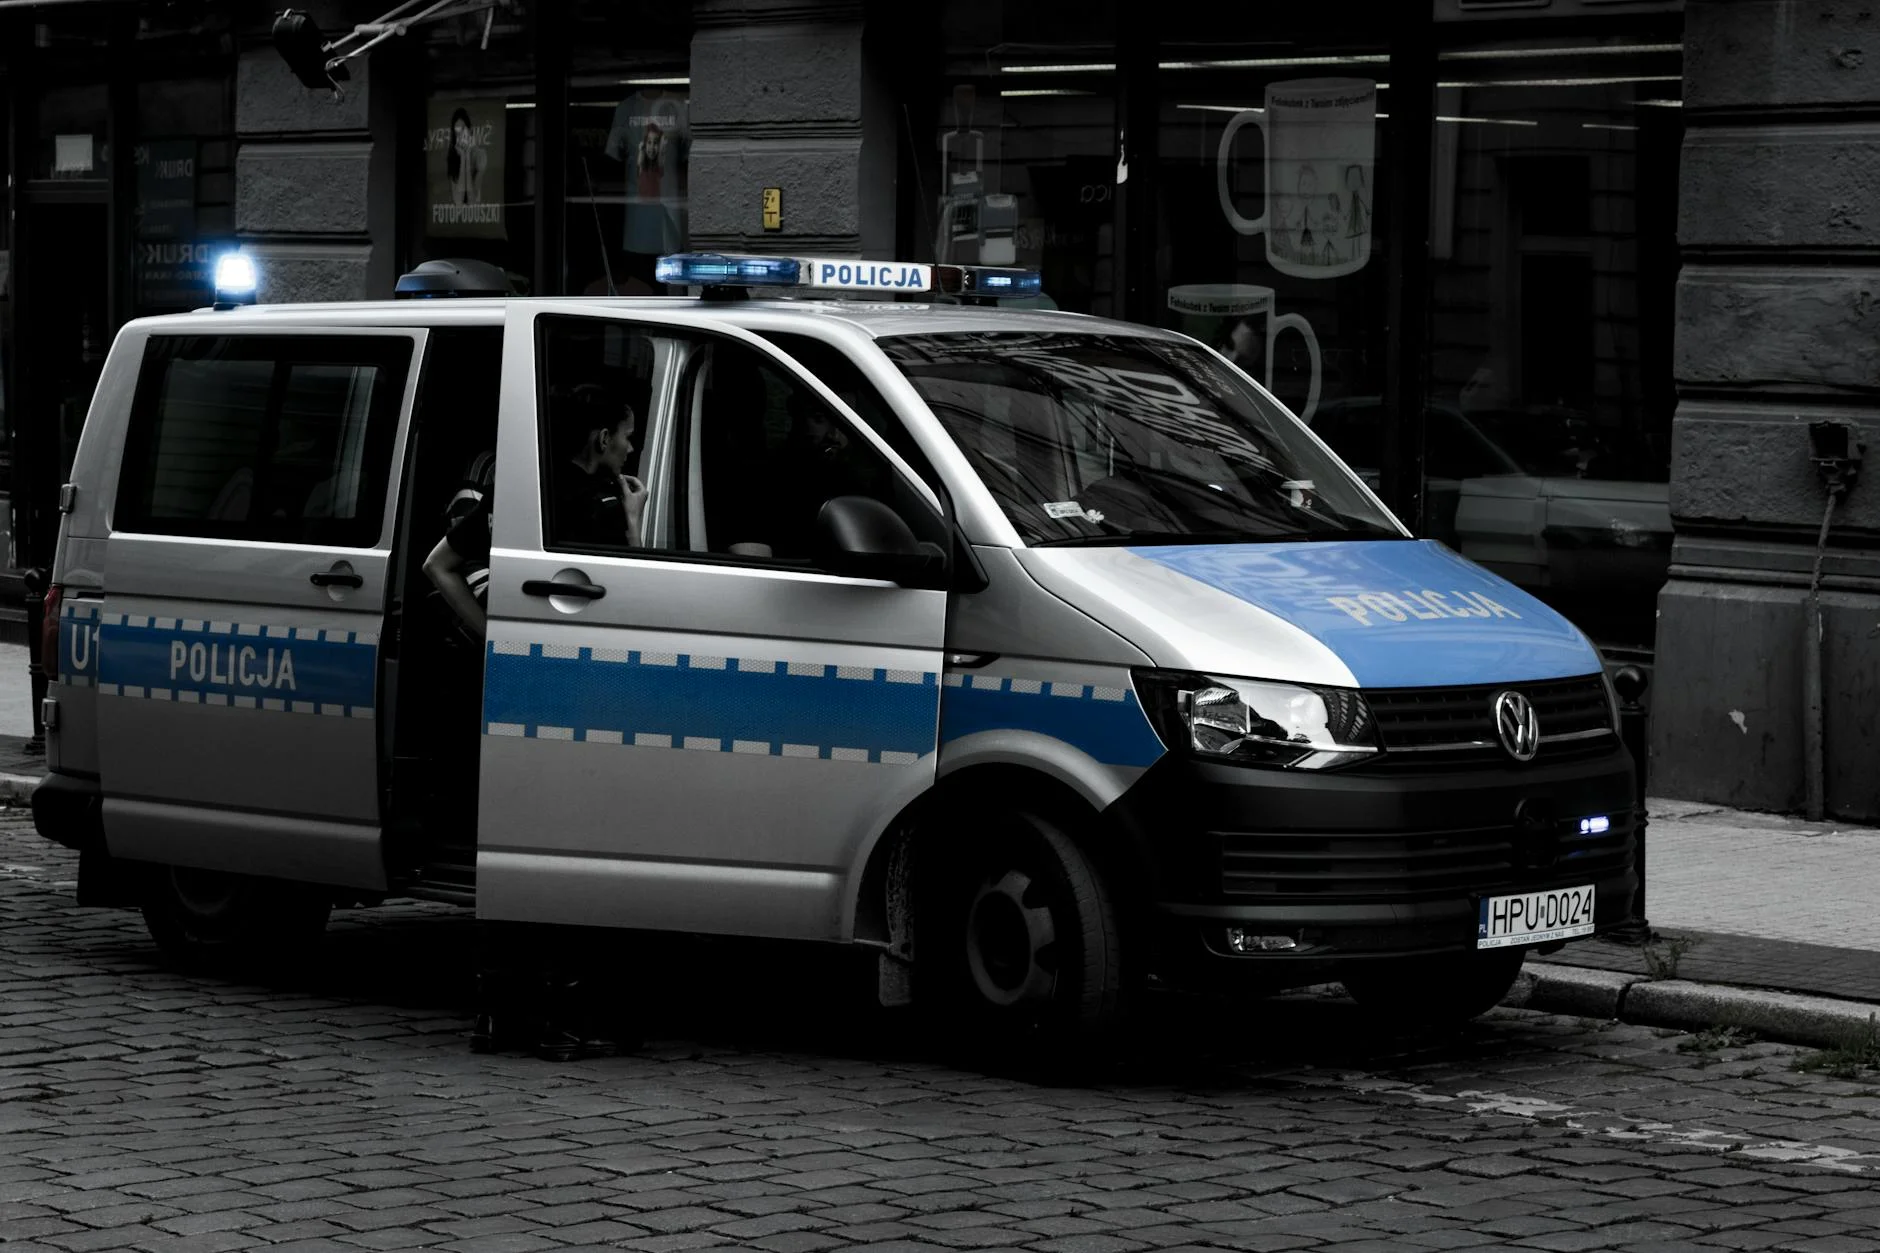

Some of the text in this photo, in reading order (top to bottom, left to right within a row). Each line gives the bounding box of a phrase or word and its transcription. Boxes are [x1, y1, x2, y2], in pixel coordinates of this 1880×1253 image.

[821, 263, 924, 288] POLICJA
[1325, 589, 1524, 627] POLICJA
[170, 639, 297, 691] POLICJA
[1492, 889, 1592, 935] HPU D024
[1478, 939, 1502, 947] POLICJA
[1479, 924, 1488, 934] PL
